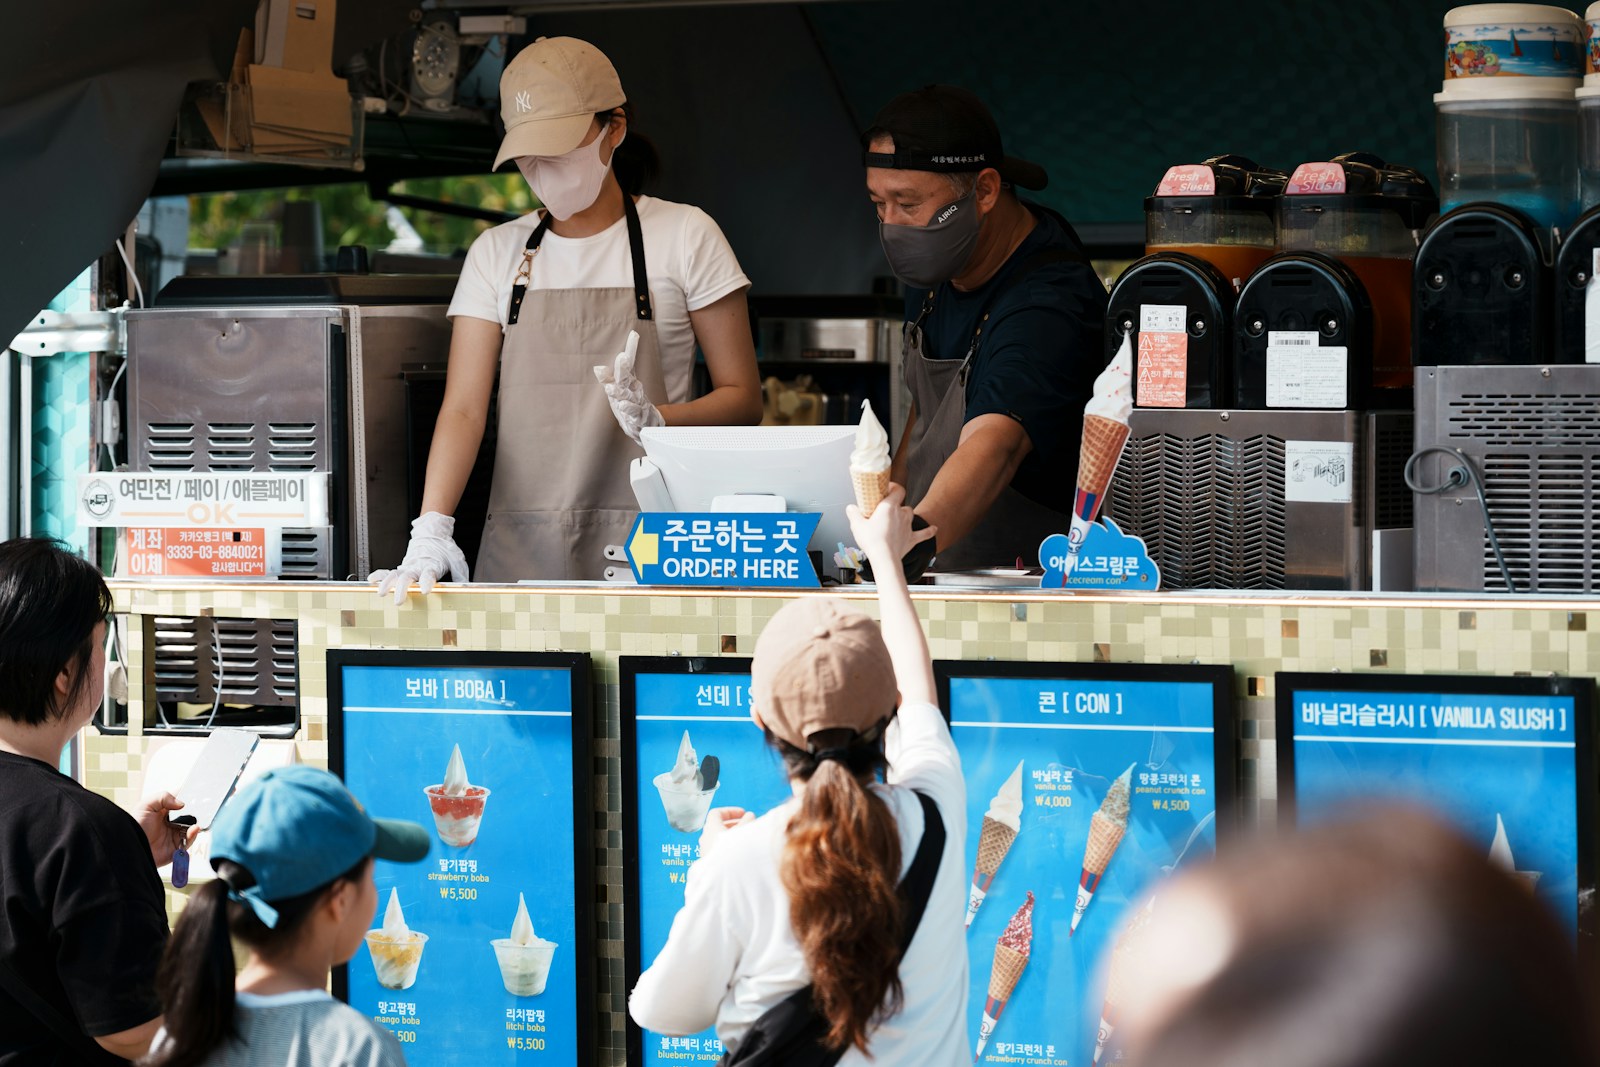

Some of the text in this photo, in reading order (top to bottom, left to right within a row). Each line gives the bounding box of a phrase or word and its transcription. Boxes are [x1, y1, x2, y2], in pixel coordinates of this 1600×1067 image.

[1168, 172, 1200, 182] Fresh
[1296, 170, 1335, 182] Fresh
[1179, 183, 1210, 193] Slush
[1302, 181, 1342, 192] Slush
[937, 204, 959, 224] AIRIQ
[119, 478, 171, 501] 여민전
[184, 479, 219, 501] 페이
[232, 479, 304, 502] 애플페이
[186, 503, 236, 525] OK
[130, 529, 163, 550] 계좌
[662, 519, 800, 554] 주문하는 곳
[166, 545, 263, 560] 3333-03-8840021
[131, 553, 163, 575] 이체
[662, 557, 799, 579] ORDER HERE
[406, 678, 438, 698] 보바
[454, 680, 495, 699] BOBA
[696, 685, 730, 706] 선데
[1039, 692, 1056, 713] 콘
[1075, 693, 1110, 714] CON
[1302, 703, 1415, 728] 바닐라슬러시
[1431, 706, 1496, 729] VANILLA
[1500, 708, 1555, 730] SLUSH
[1032, 770, 1074, 783] 바닐라 콘
[1139, 773, 1201, 787] 땅콩크런치 콘
[1135, 786, 1162, 794] peanut
[1163, 787, 1190, 795] crunch
[1035, 796, 1072, 808] ₩4,000
[1152, 800, 1190, 812] ₩4,500
[661, 844, 692, 857] 바닐라
[439, 859, 478, 873] 딸기팝핑
[661, 858, 685, 866] vanila
[428, 873, 490, 882] strawberry boba
[440, 887, 478, 901] ₩5,500
[378, 1001, 416, 1016] 망고팝핑
[506, 1008, 545, 1023] 리치팝핑
[374, 1016, 421, 1026] mango boba
[505, 1021, 546, 1032] litchi boba
[507, 1037, 545, 1051] ₩5,500
[703, 1039, 723, 1053] 선데
[996, 1042, 1056, 1057] 딸기크런치 콘
[657, 1049, 722, 1062] blueberry sunda
[985, 1054, 1025, 1064] strawberry
[1026, 1057, 1052, 1065] crunch
